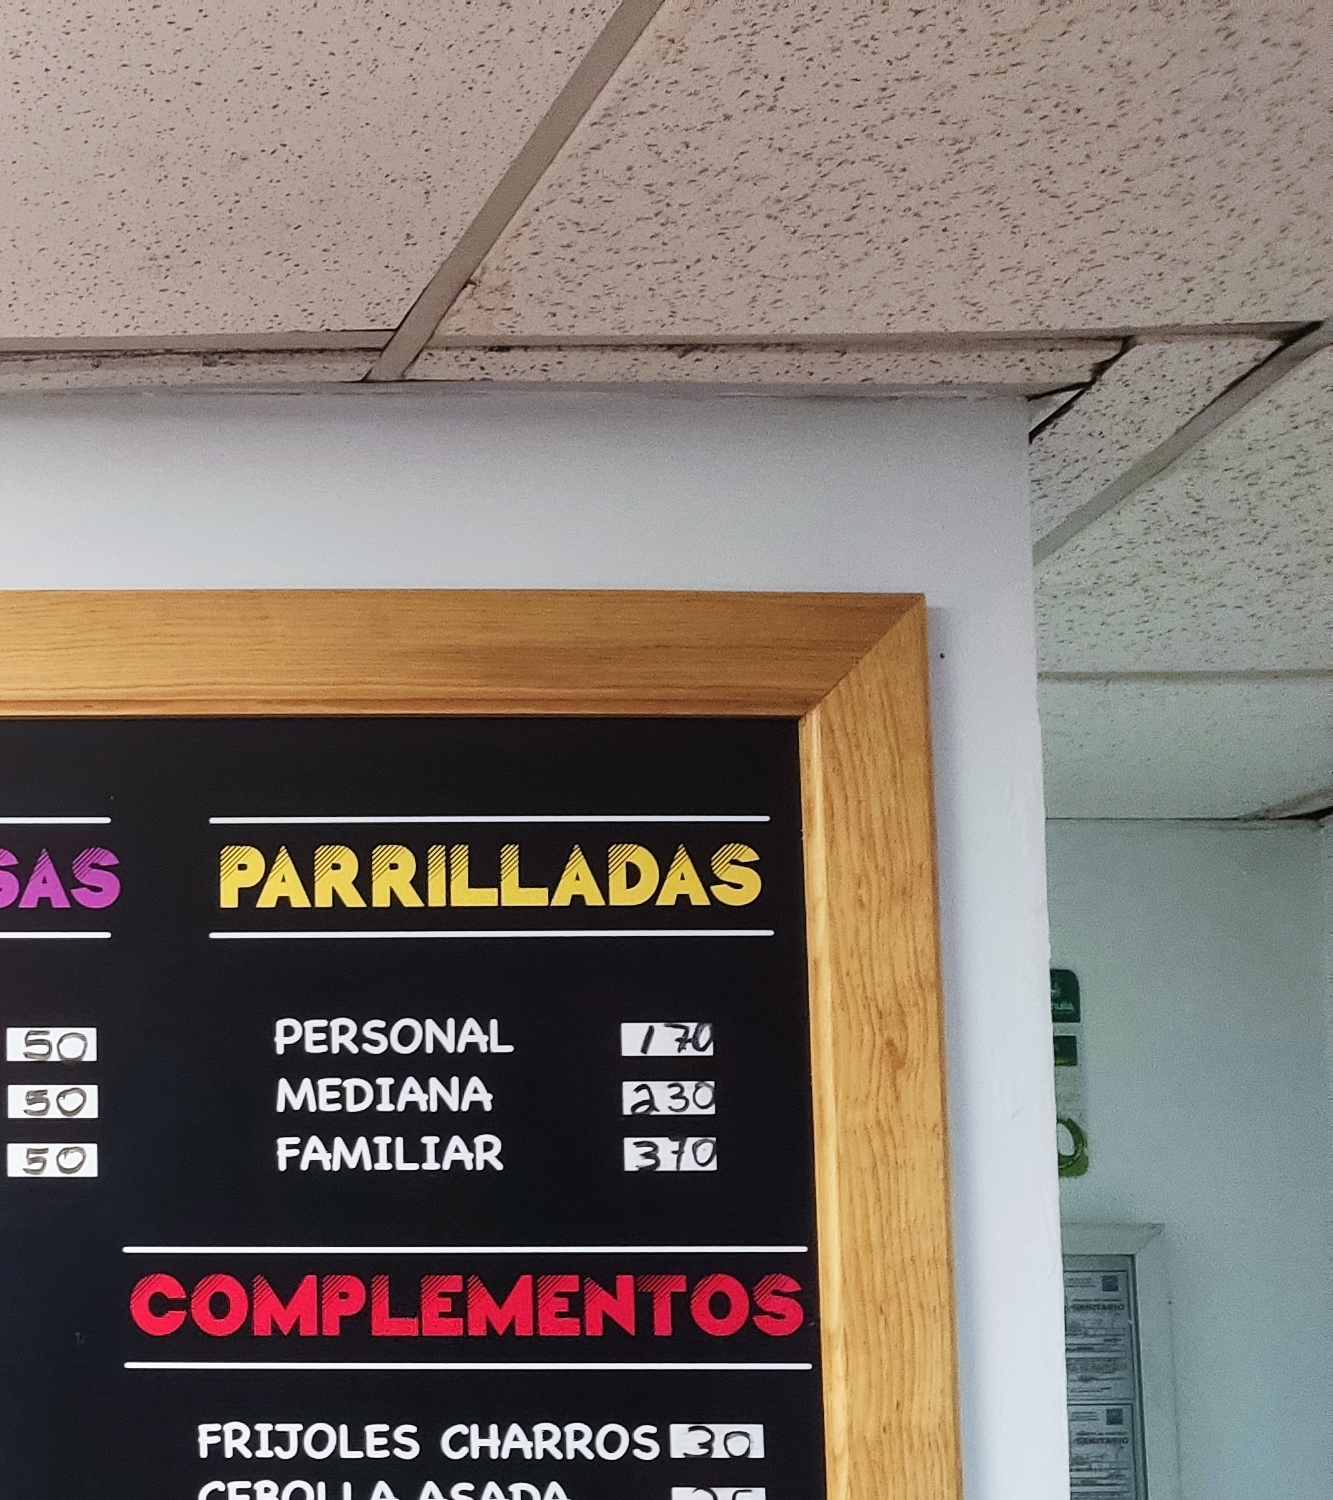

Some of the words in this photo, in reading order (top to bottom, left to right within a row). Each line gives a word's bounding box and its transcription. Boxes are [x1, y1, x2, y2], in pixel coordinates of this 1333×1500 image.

[220, 844, 761, 908] PARRILLADAS
[23, 1030, 88, 1062] 50
[274, 1018, 514, 1054] PERSONAL
[640, 1023, 713, 1054] 170
[23, 1087, 87, 1117] 50
[277, 1076, 493, 1112] MEDIANA
[631, 1083, 714, 1114] 230
[22, 1146, 86, 1175] 50
[277, 1134, 503, 1171] FAMILIAR
[633, 1136, 717, 1171] 370
[130, 1274, 803, 1336] COMPLEMENTOS
[198, 1422, 419, 1459] FRIJOLES
[441, 1423, 659, 1460] CHARROS
[683, 1425, 751, 1458] 30
